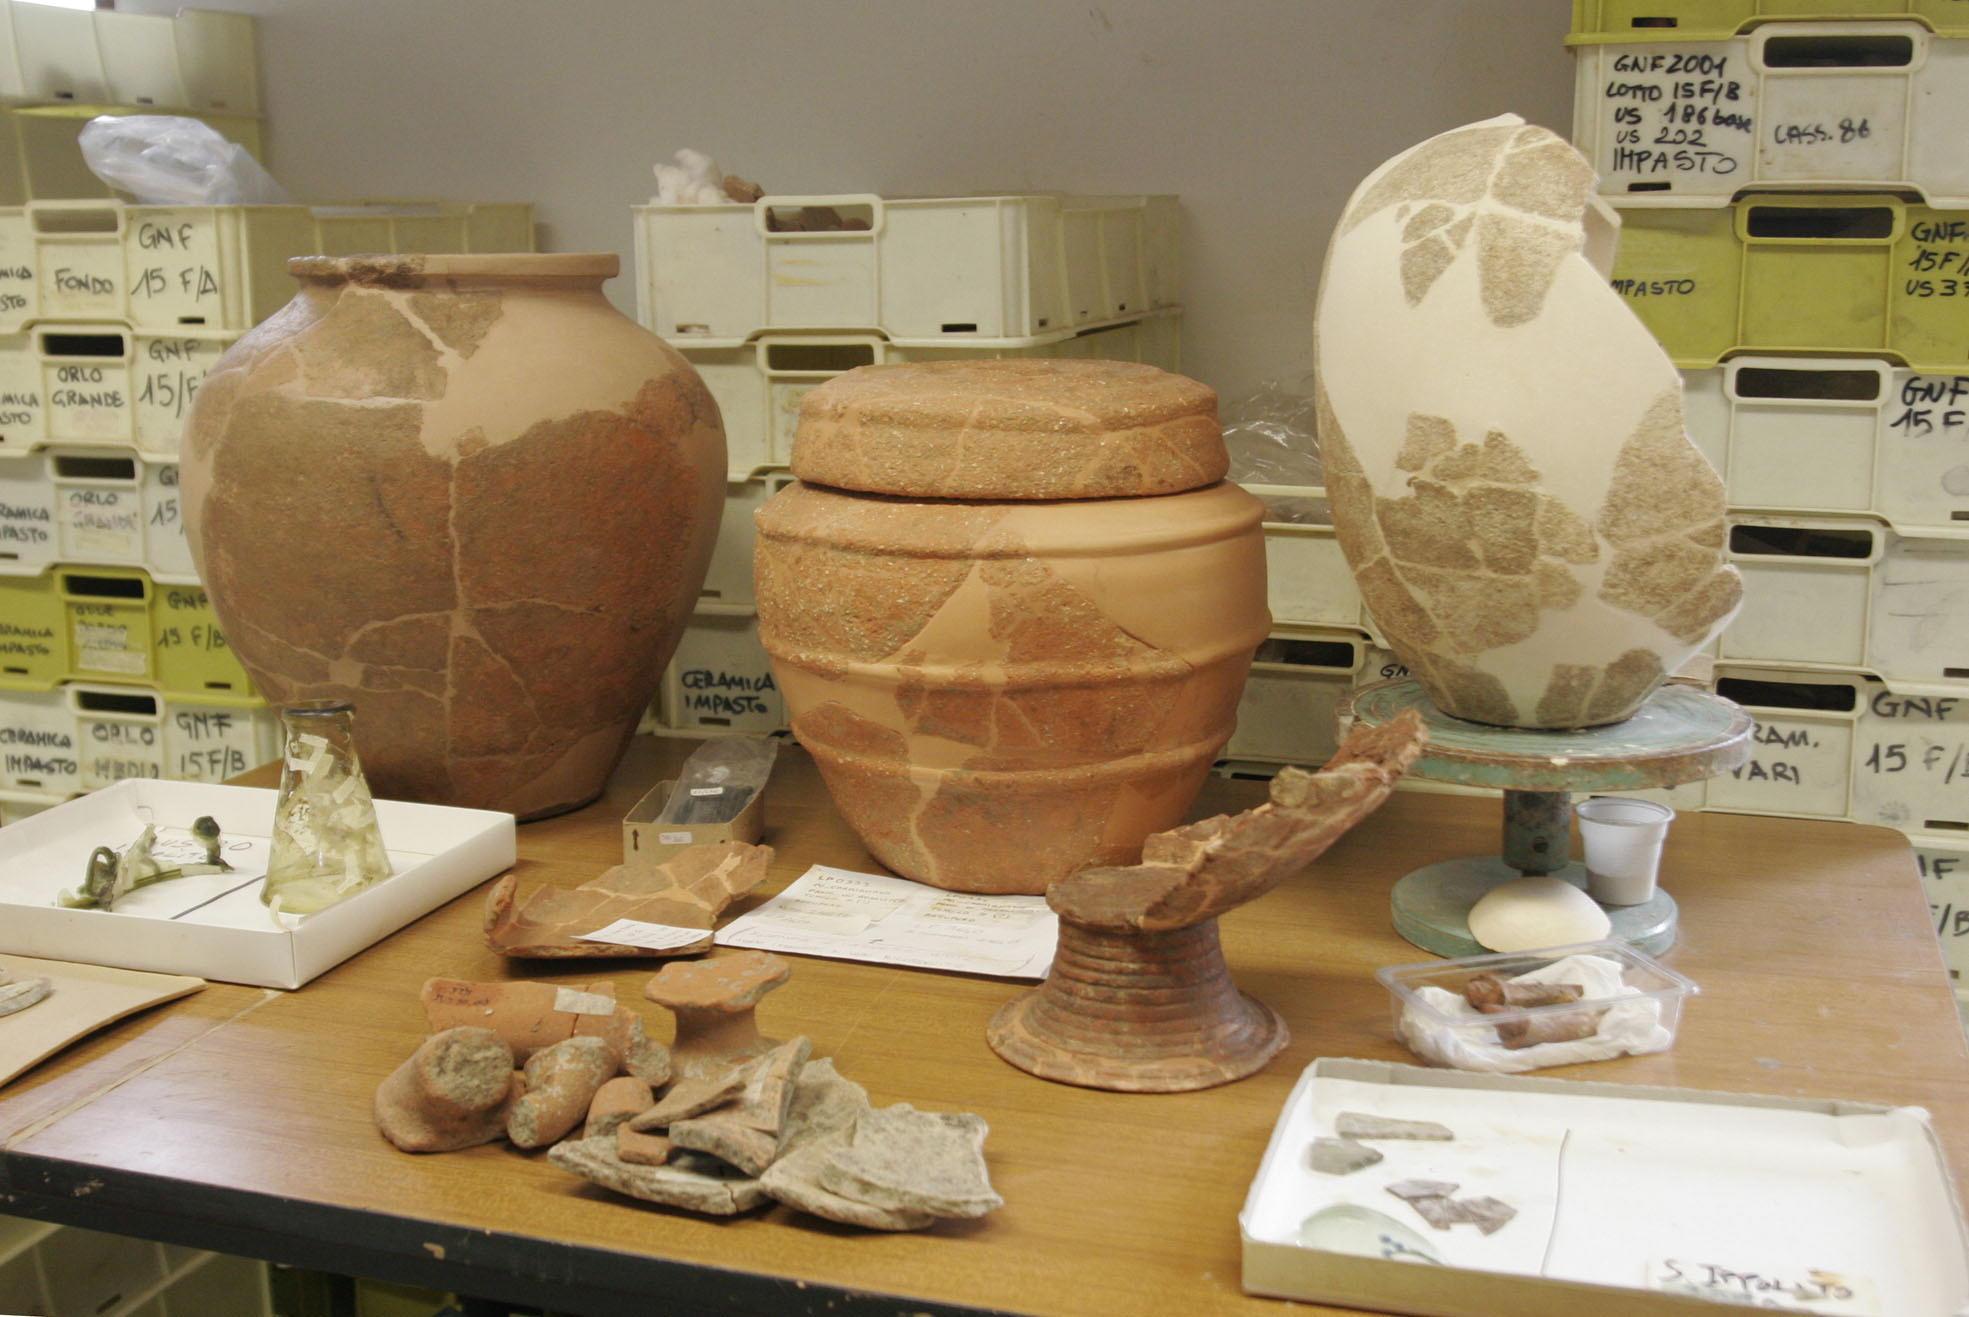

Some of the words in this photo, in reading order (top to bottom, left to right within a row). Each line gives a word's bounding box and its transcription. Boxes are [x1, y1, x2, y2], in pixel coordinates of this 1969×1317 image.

[1605, 81, 1663, 103] LOTTO
[1614, 106, 1643, 126] US
[1616, 129, 1641, 144] US
[1652, 126, 1708, 148] 202
[138, 223, 193, 249] GNF
[54, 267, 114, 294] FONDO
[149, 338, 202, 363] GNF
[57, 367, 103, 383] ORLO
[51, 390, 125, 408] GRANDE
[1901, 376, 1969, 407] GNF
[70, 490, 119, 508] ORLO
[0, 525, 48, 544] PASTO
[681, 670, 776, 691] CERAMICA
[684, 693, 769, 715] IMPASTO
[1871, 690, 1959, 721] GNF
[92, 722, 155, 746] ORLO
[176, 712, 232, 741] GNF
[0, 728, 72, 749] CERAMICA
[5, 753, 78, 775] IMPASTO
